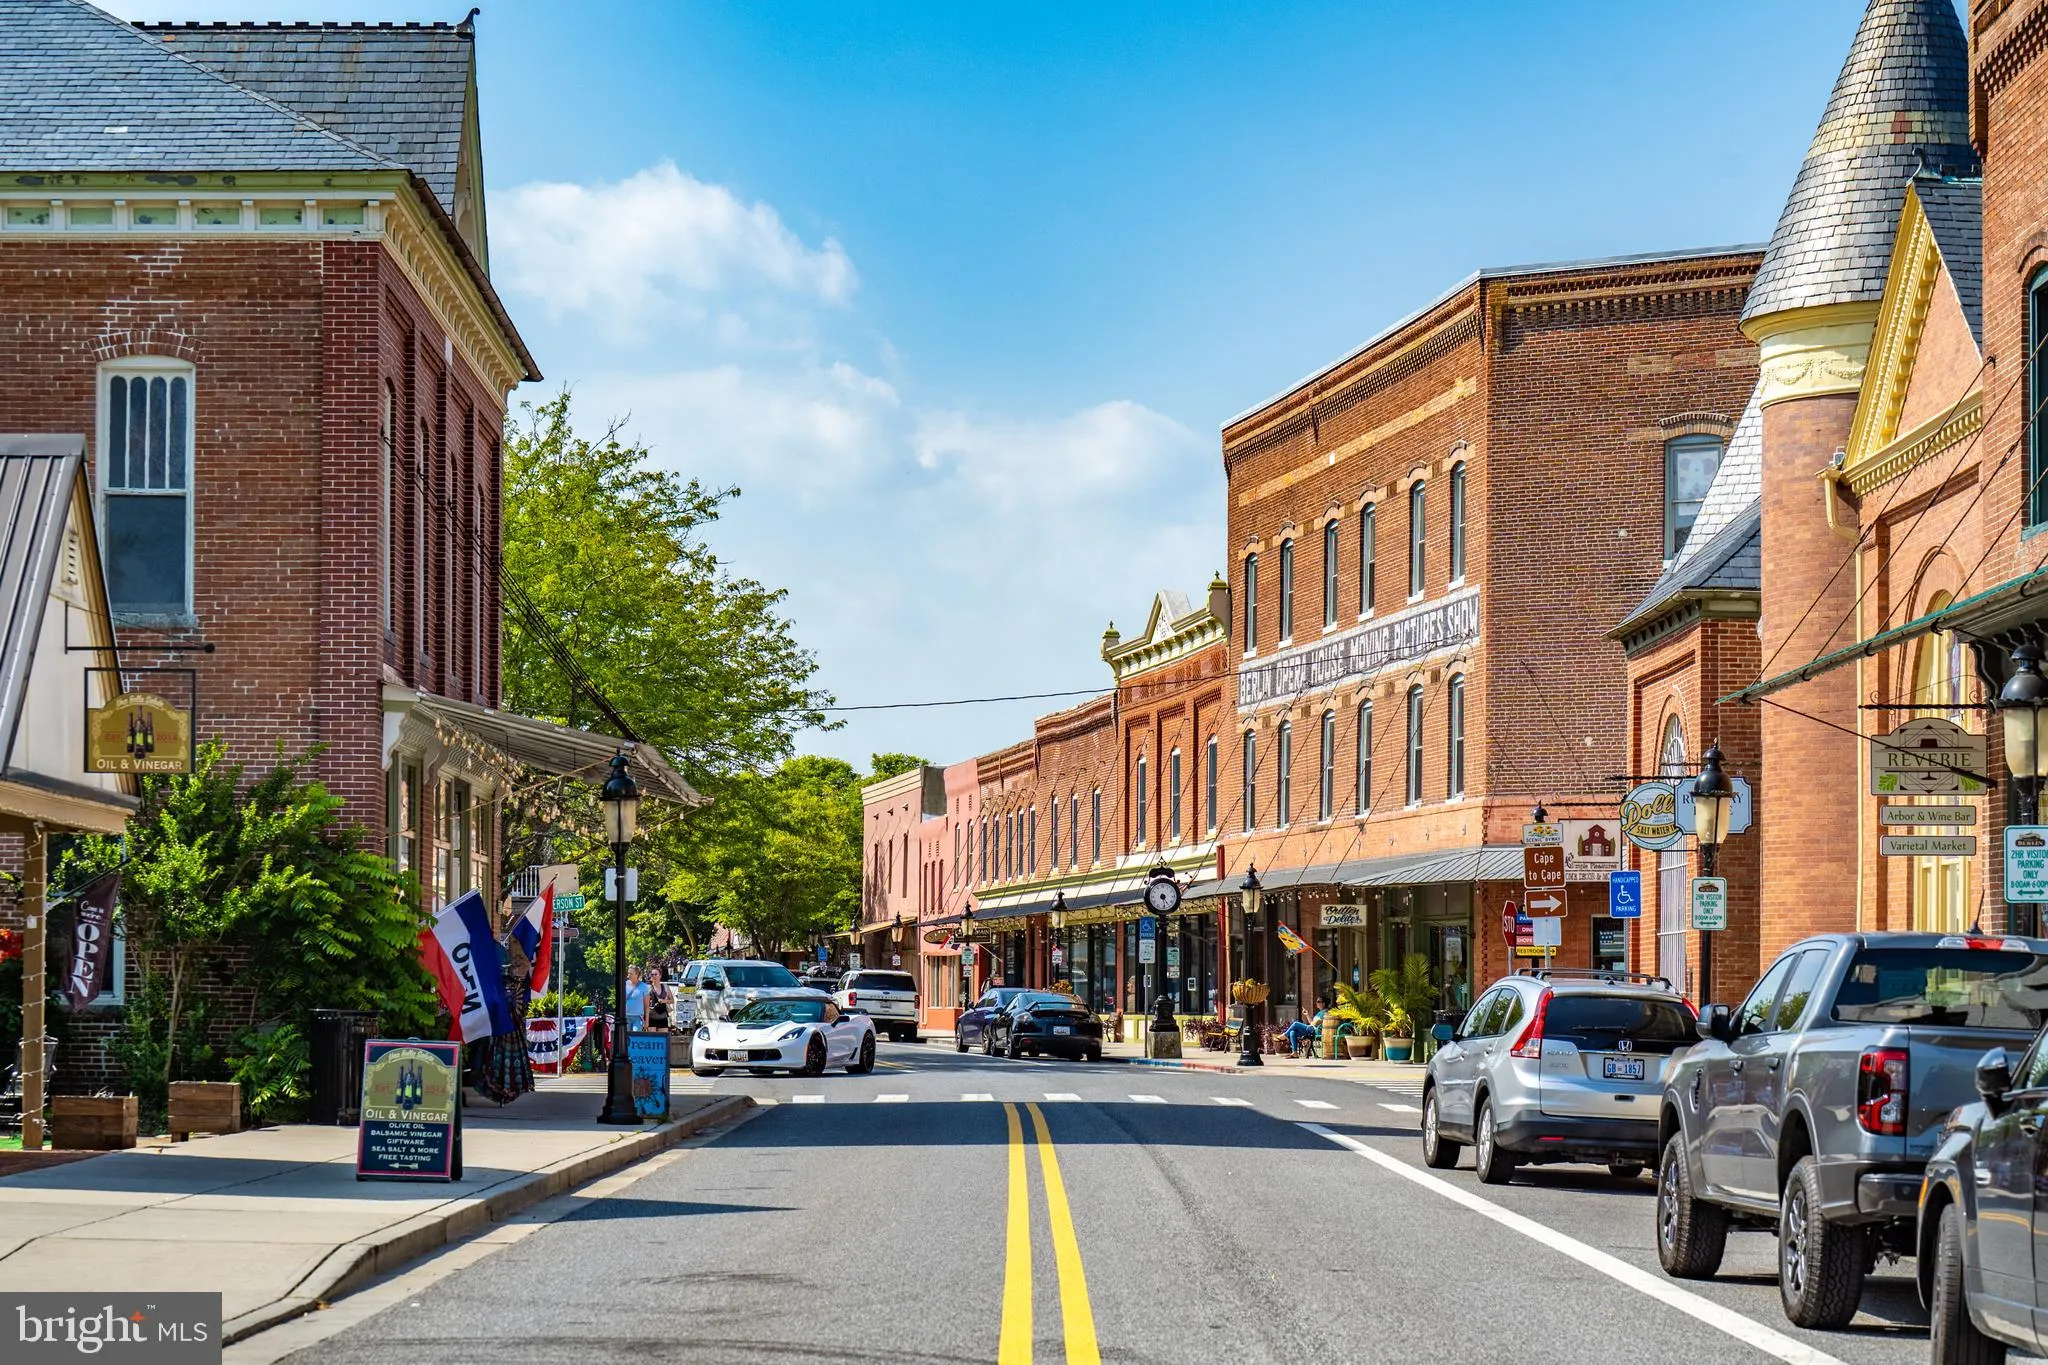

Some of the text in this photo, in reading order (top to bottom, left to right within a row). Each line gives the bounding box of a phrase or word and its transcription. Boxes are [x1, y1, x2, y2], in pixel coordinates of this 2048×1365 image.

[1240, 596, 1479, 705] BERLIN OPERA HOUSE MOVING PICTURES SHOW
[96, 758, 183, 770] OIL & VINEGAR
[1888, 753, 1972, 767] REVERIE
[1887, 811, 1971, 821] Arbor & Wine Bar
[1637, 826, 1650, 835] SALT
[1651, 826, 1670, 835] WATER
[1890, 840, 1967, 851] Varietal Market
[1534, 852, 1554, 864] Cape
[2011, 849, 2048, 859] 2HR VISITO
[2017, 860, 2045, 869] PARKING
[1528, 869, 1561, 881] to Cape
[2023, 870, 2039, 879] ONLY
[575, 896, 583, 908] ST
[1504, 915, 1515, 933] STO
[68, 923, 101, 998] OPEN
[627, 1036, 664, 1051] ream
[631, 1055, 667, 1065] eaver
[1607, 1063, 1641, 1074] GB 1857
[365, 1108, 448, 1121] OIL & VINEGAR
[370, 1129, 443, 1138] BALSAMIC VINEGAR
[400, 1154, 431, 1162] TASTING
